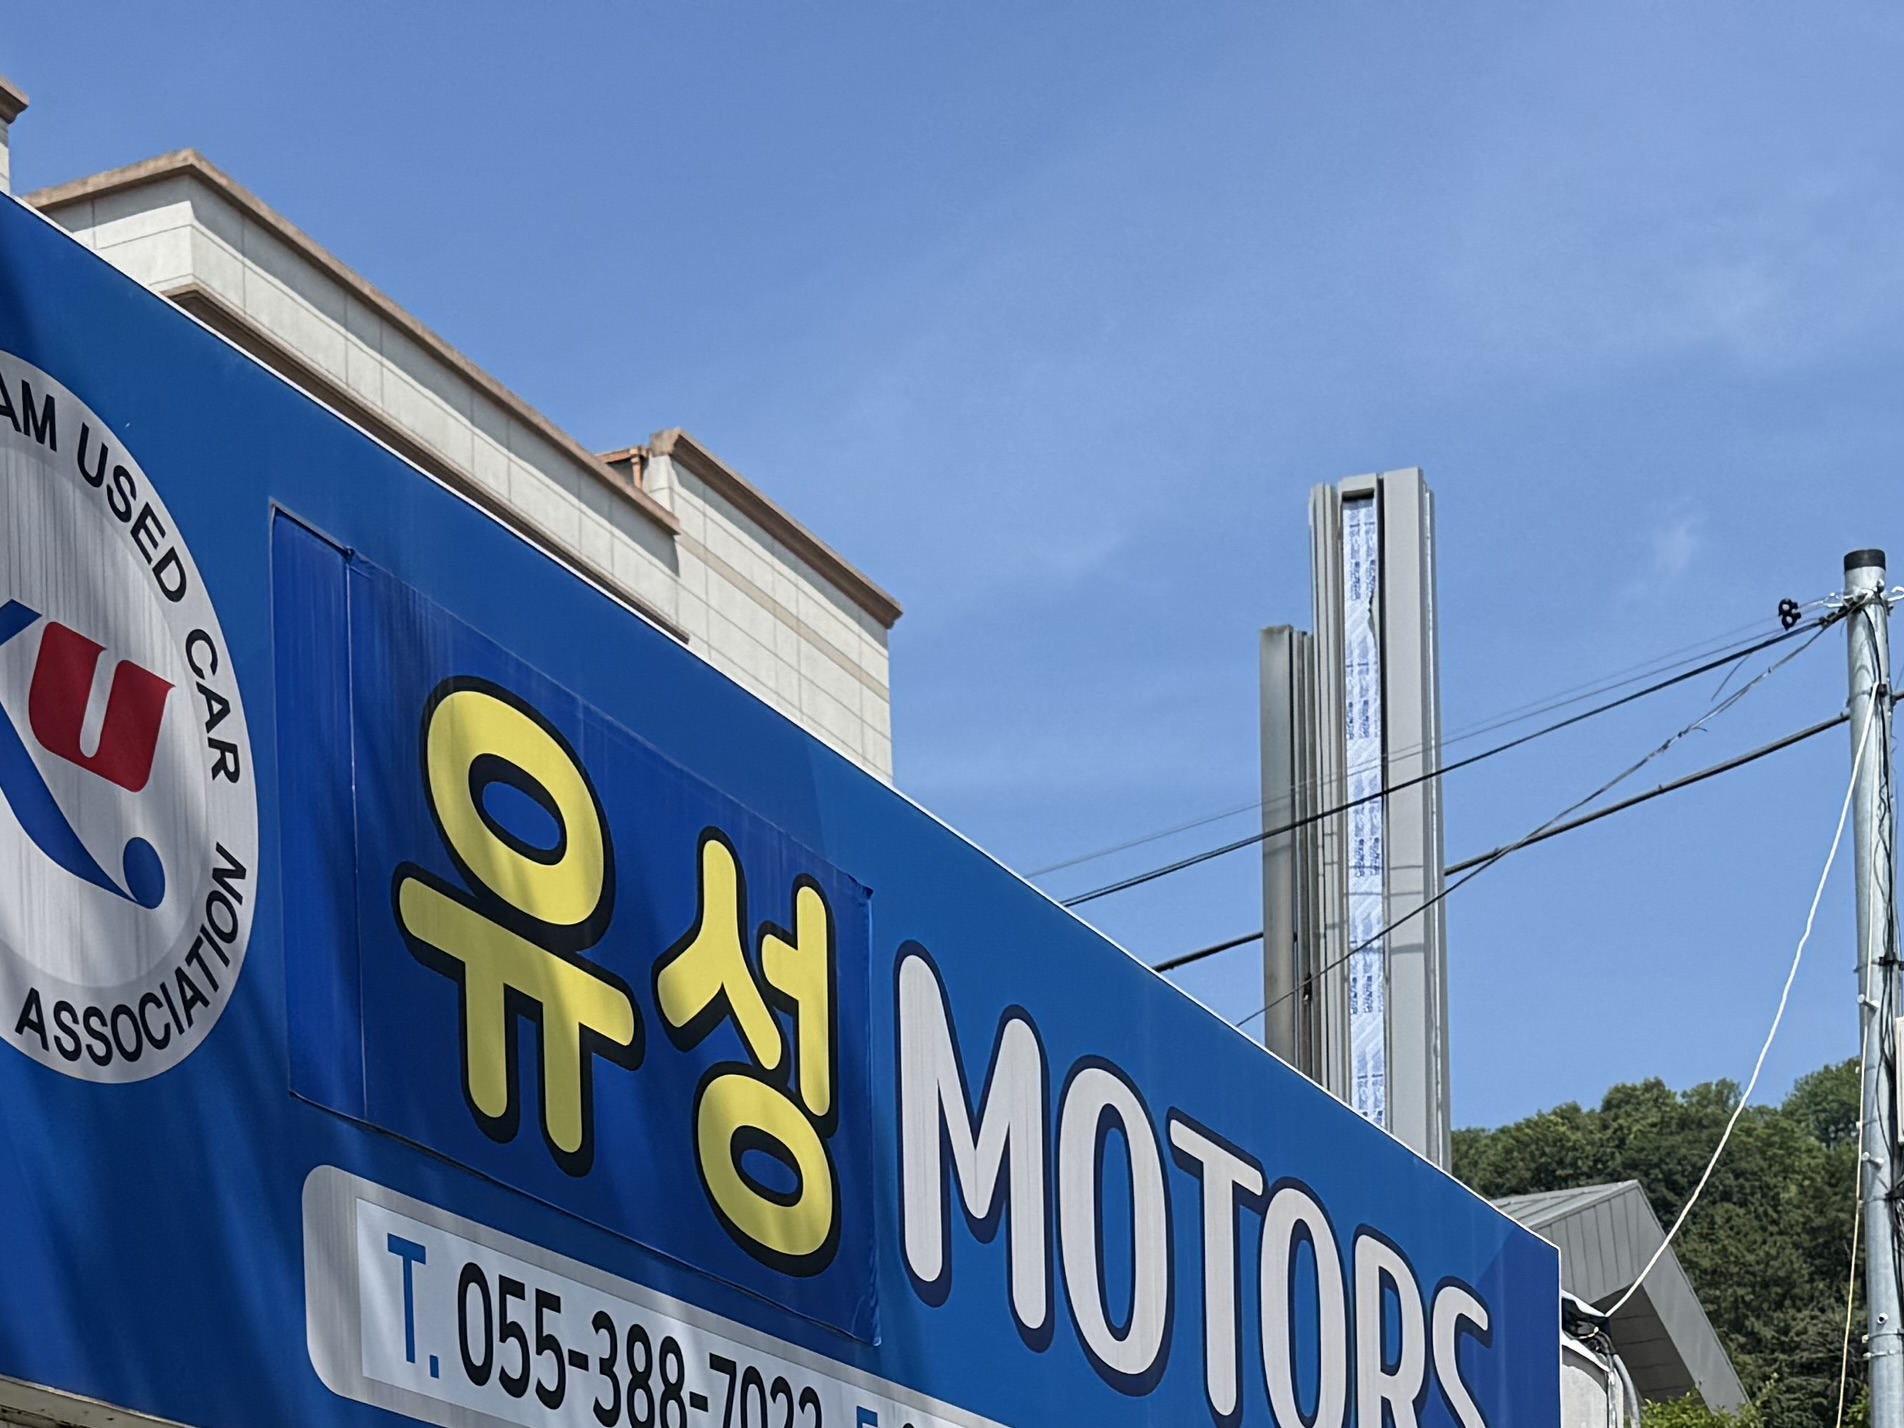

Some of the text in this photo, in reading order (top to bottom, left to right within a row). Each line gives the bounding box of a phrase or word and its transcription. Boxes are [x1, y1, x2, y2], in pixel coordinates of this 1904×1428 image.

[77, 422, 188, 603] USED
[185, 628, 241, 785] CAR
[15, 842, 247, 1066] ASSOCIATION
[399, 690, 833, 1256] 유성
